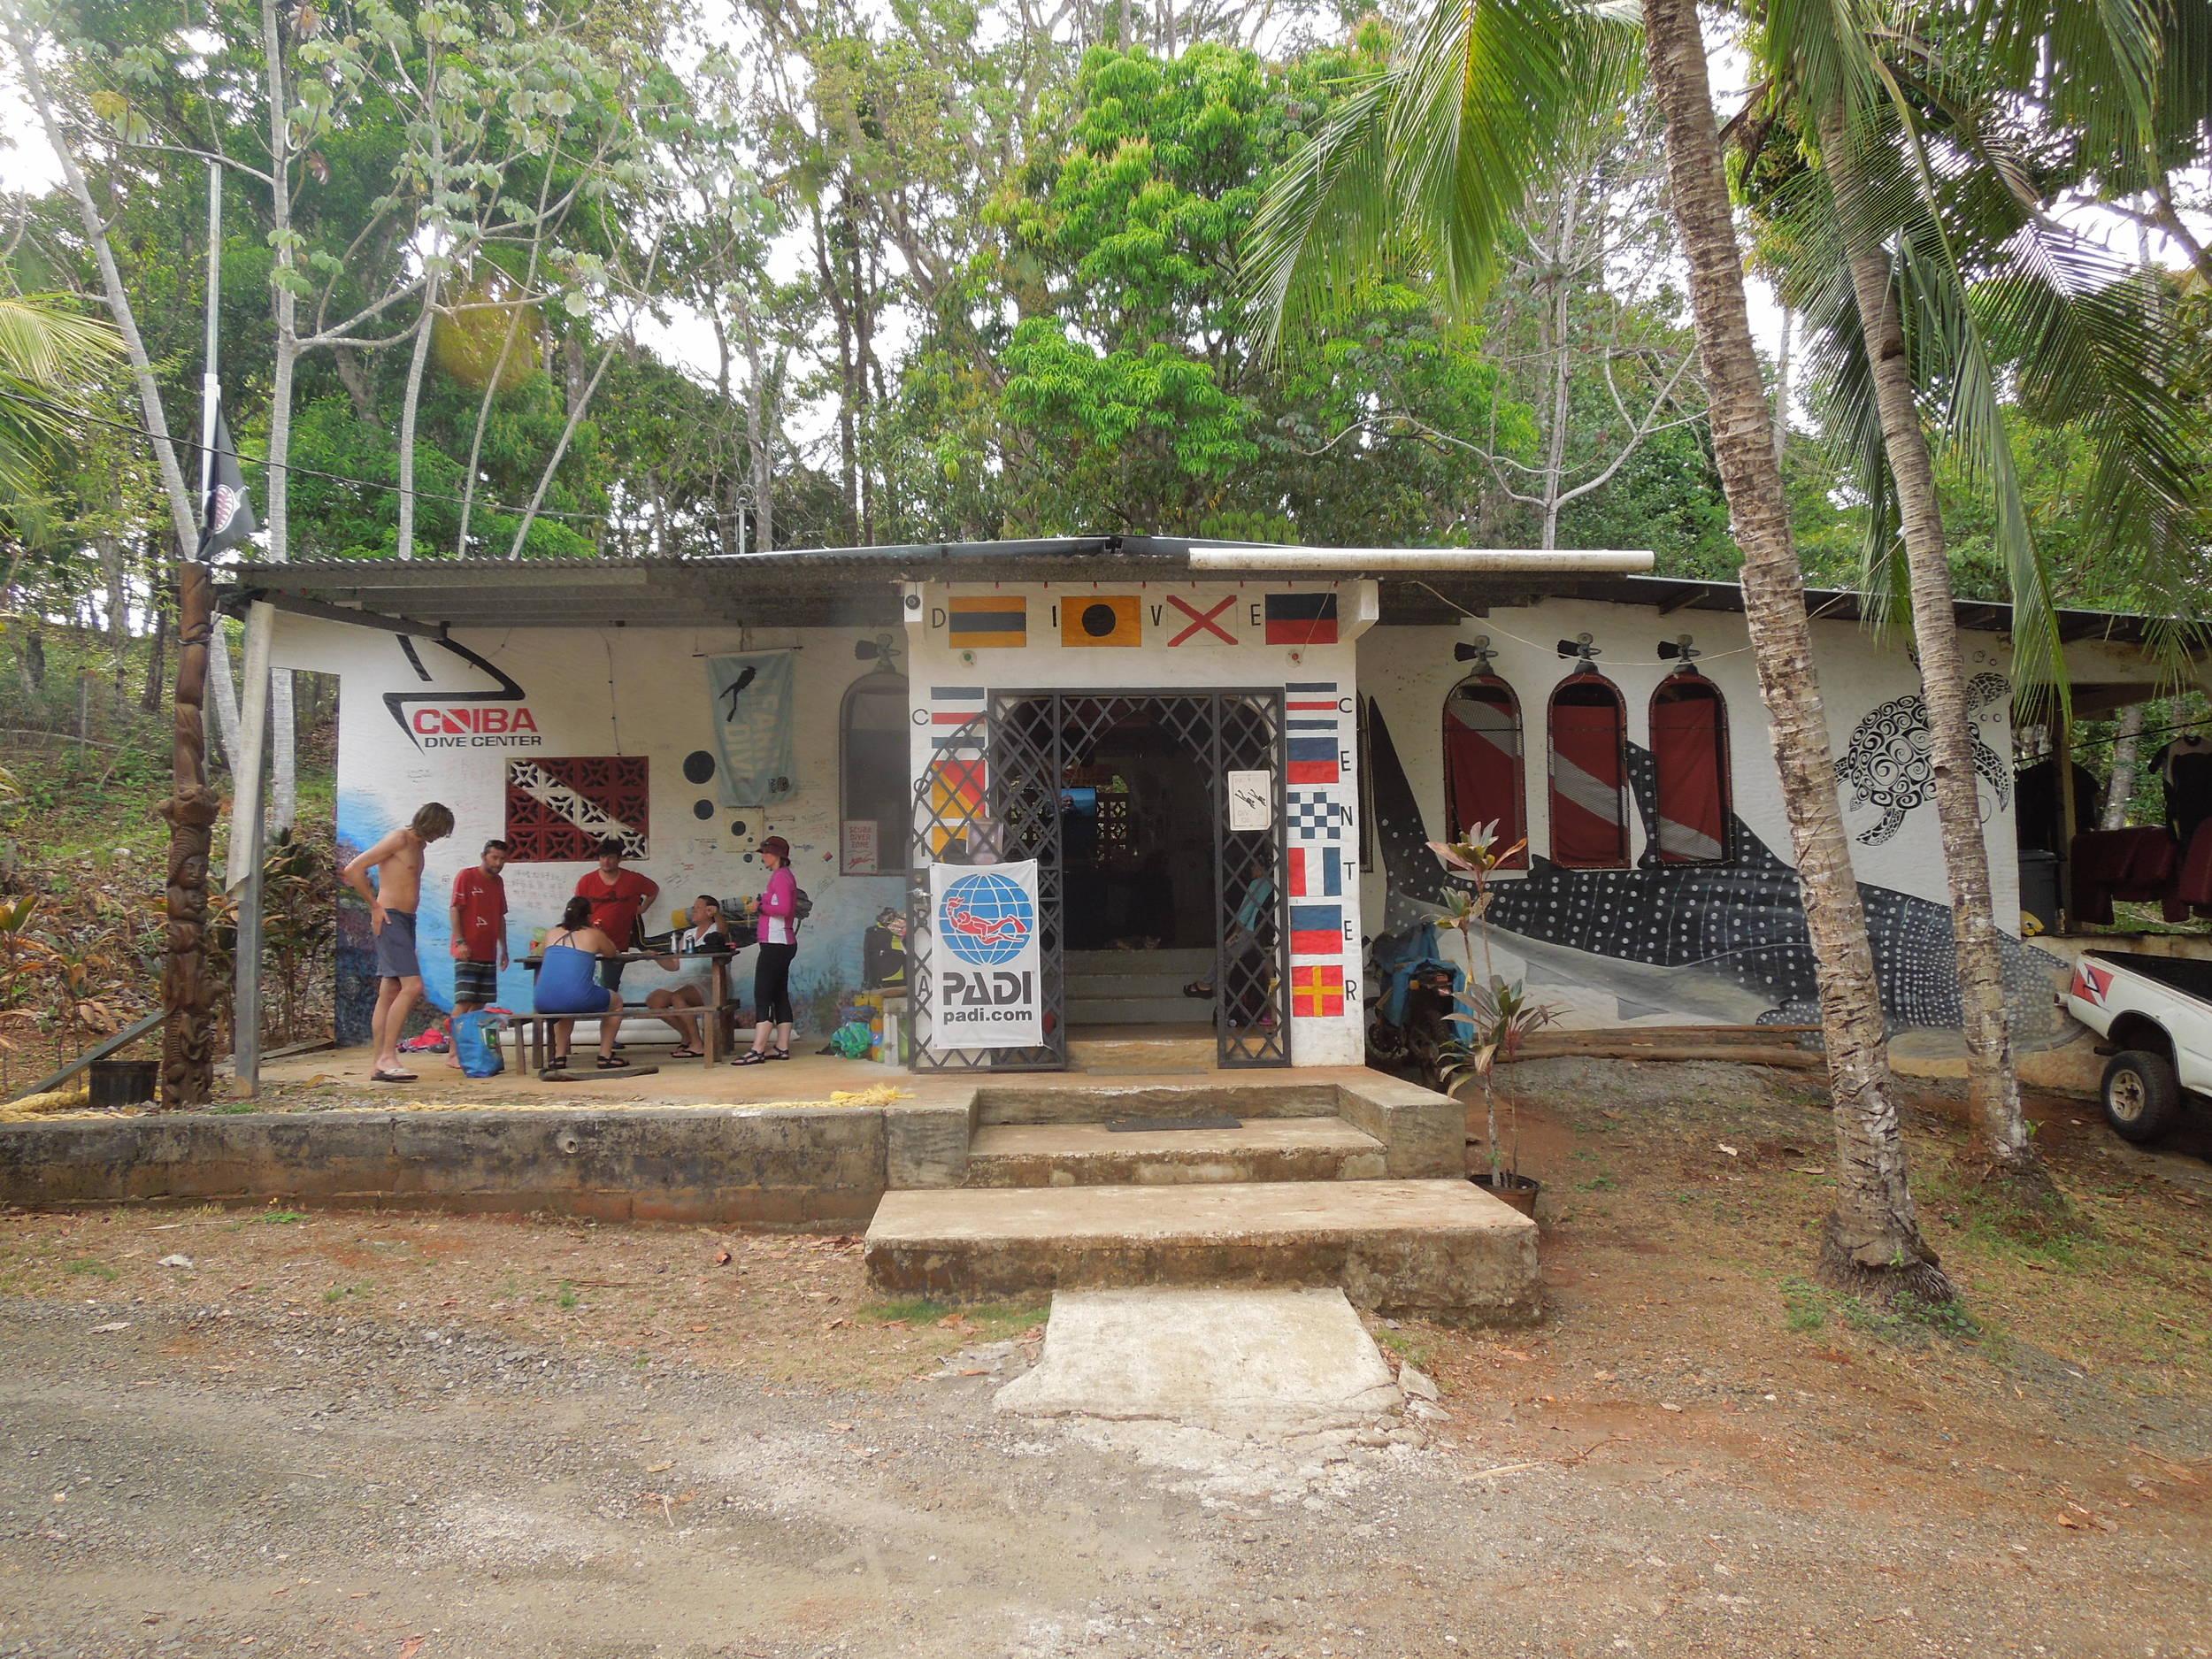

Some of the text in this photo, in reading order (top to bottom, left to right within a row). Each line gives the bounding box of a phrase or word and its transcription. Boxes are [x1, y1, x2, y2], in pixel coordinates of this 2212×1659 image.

[413, 708, 538, 733] COIBA
[425, 735, 541, 748] DIVE CENTER
[943, 972, 1033, 1005] PADI
[943, 1008, 1033, 1025] padi.com
